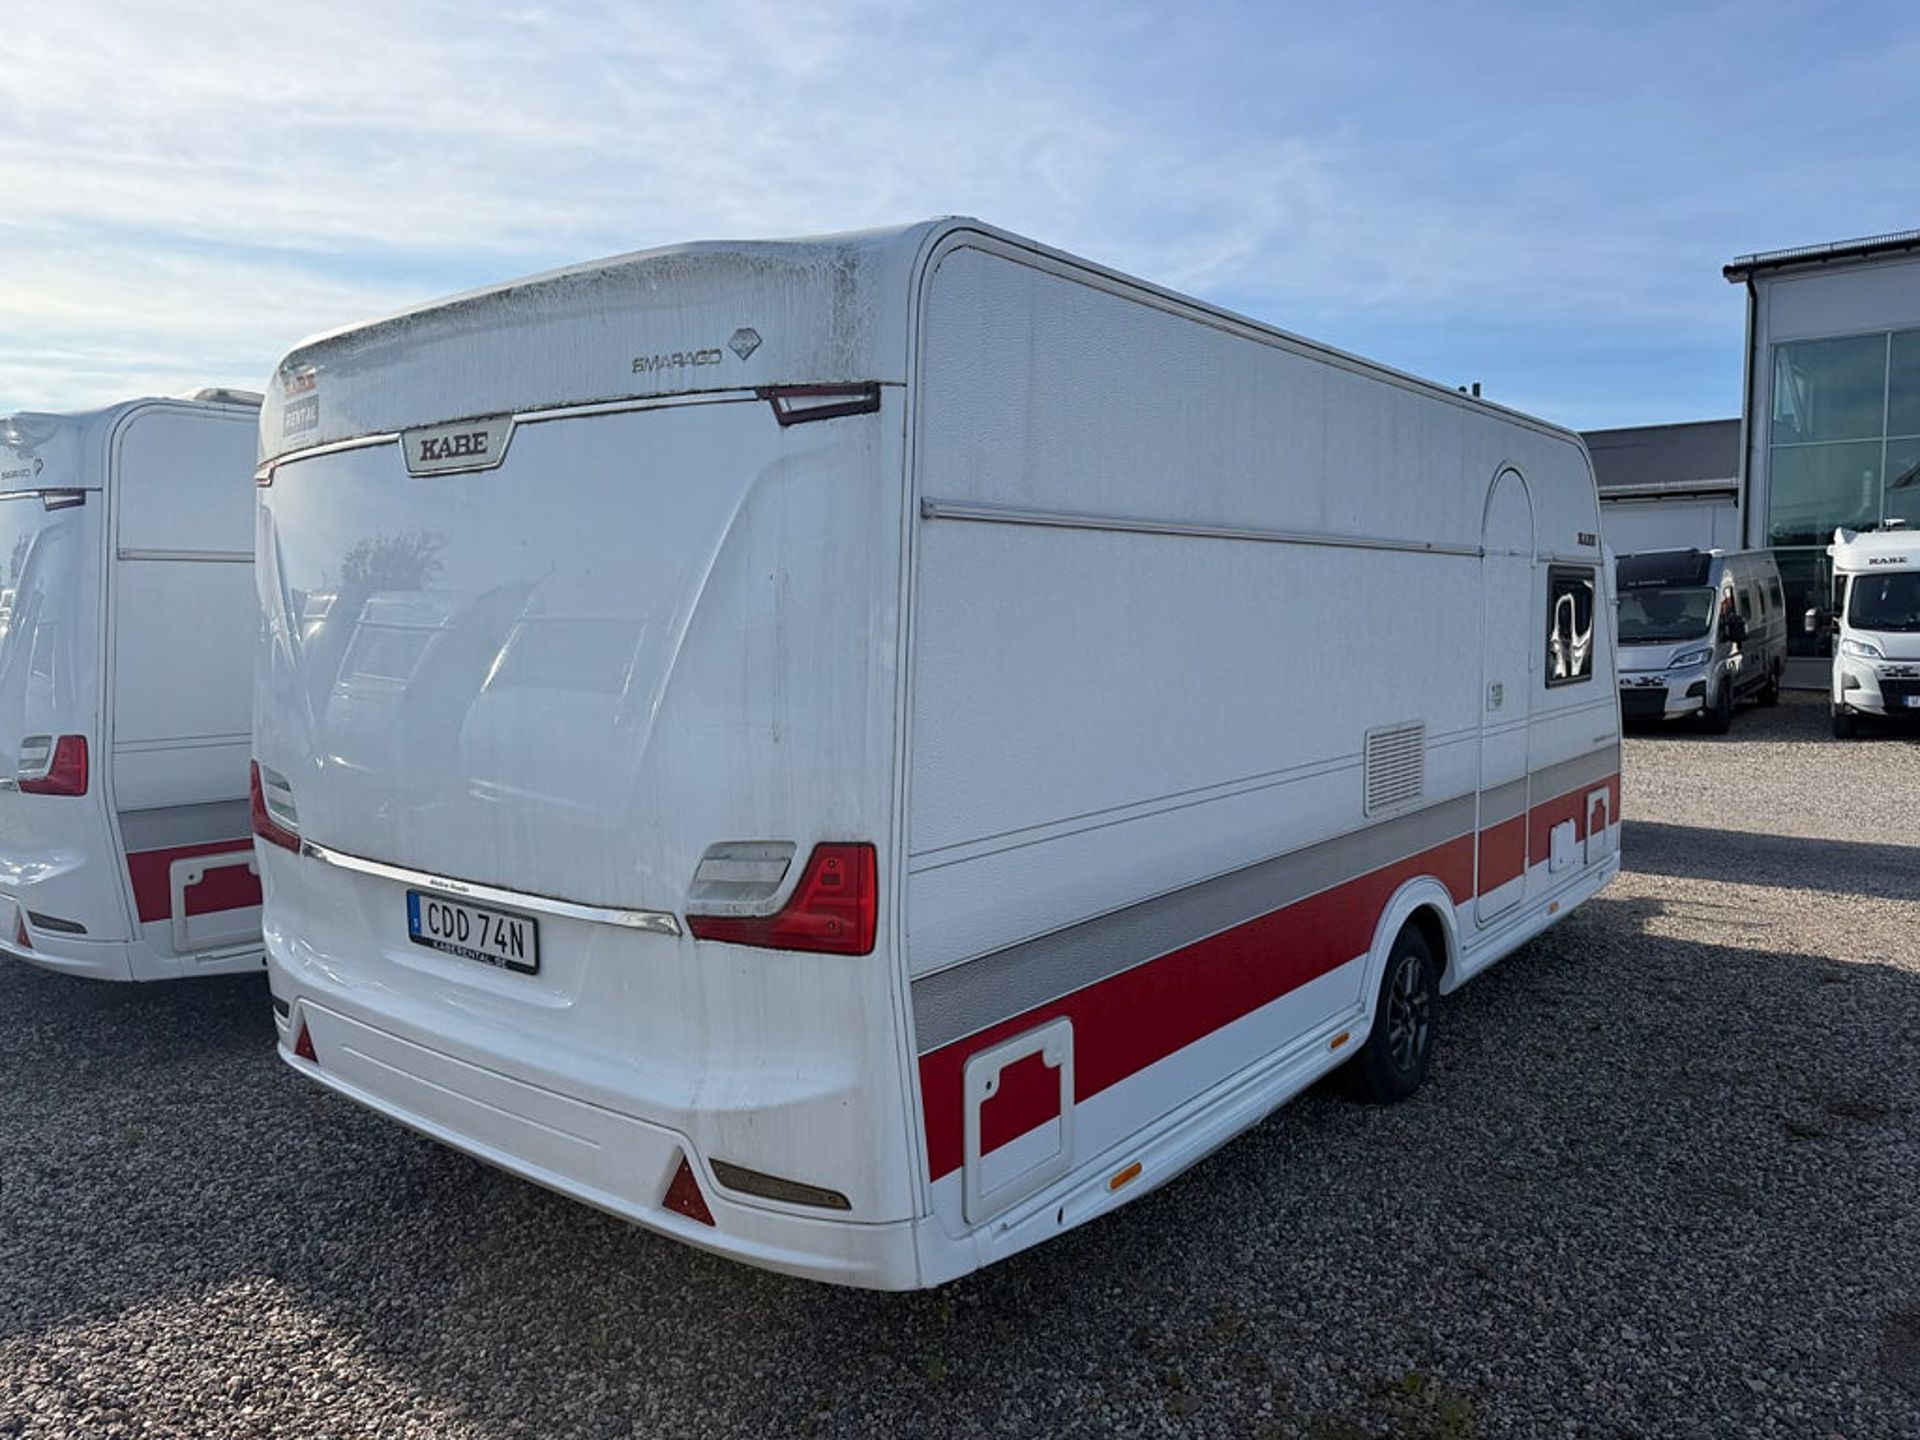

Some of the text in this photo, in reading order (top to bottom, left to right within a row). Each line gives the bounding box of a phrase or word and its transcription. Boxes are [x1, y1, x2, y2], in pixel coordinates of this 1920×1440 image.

[420, 431, 488, 461] KABE
[1868, 556, 1908, 566] KABE
[428, 902, 524, 959] CDD 74N
